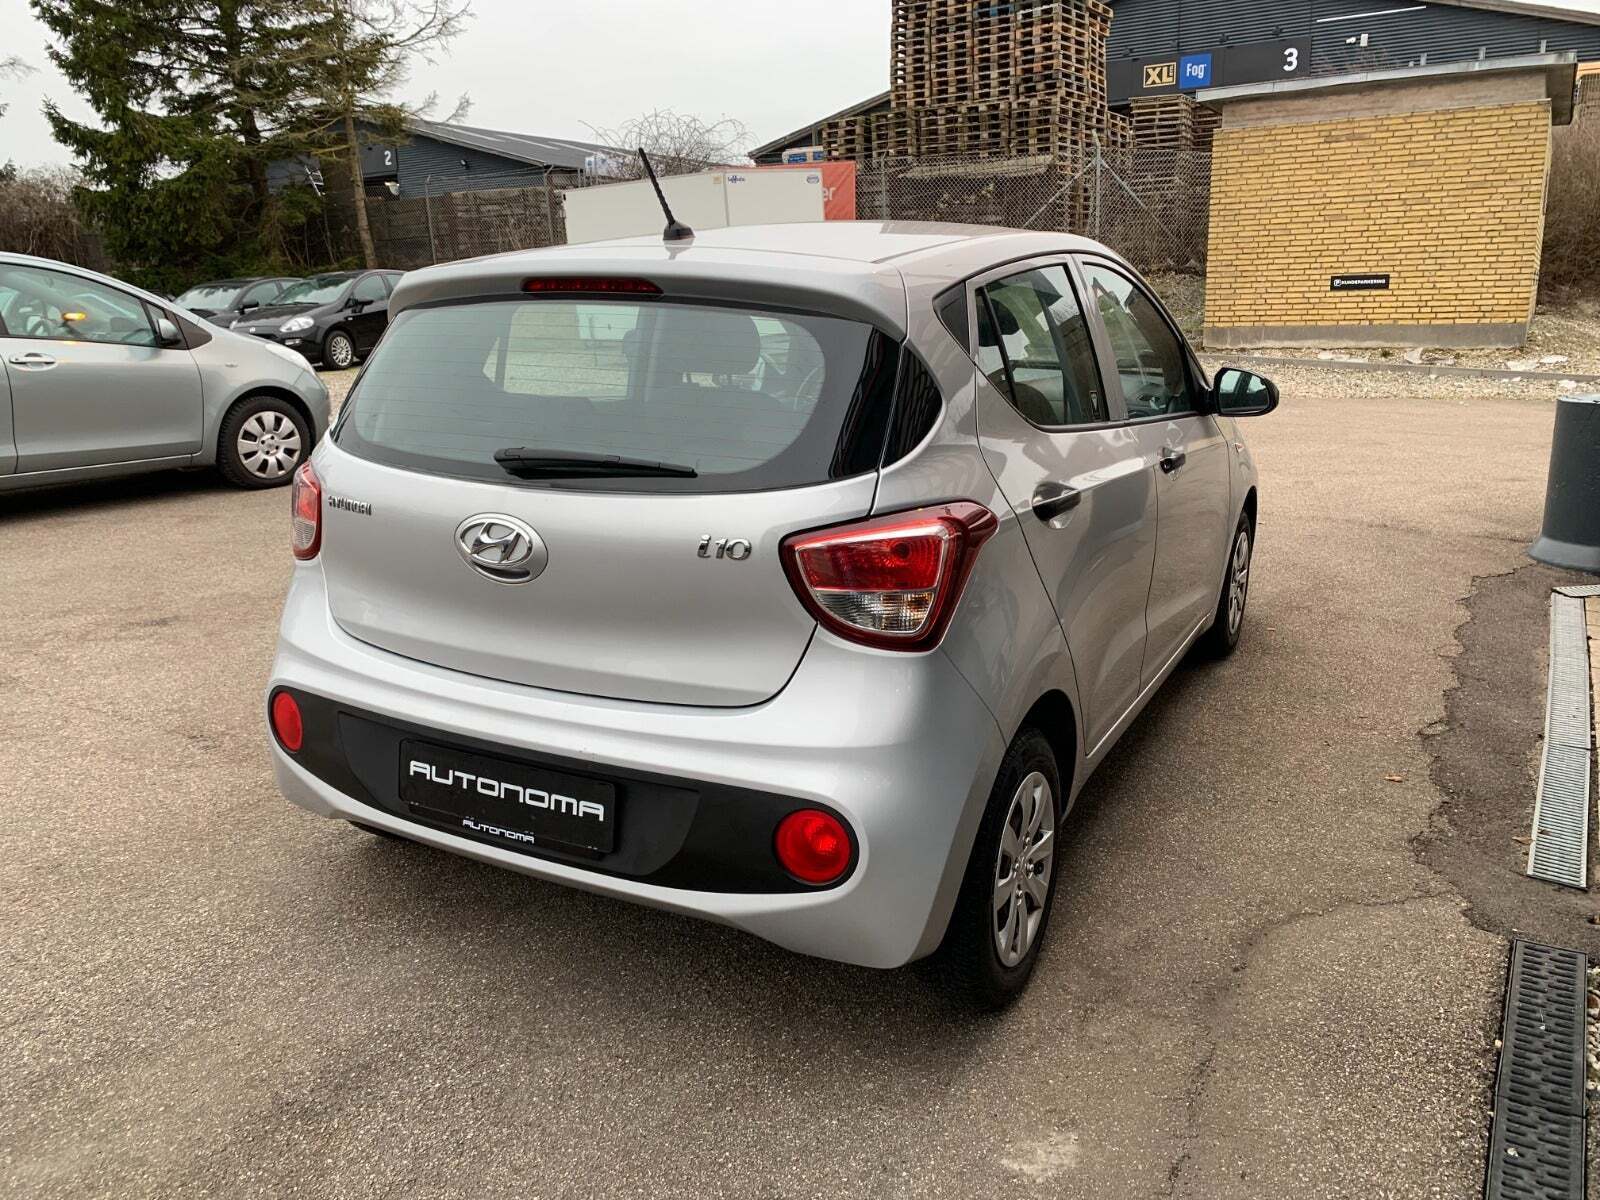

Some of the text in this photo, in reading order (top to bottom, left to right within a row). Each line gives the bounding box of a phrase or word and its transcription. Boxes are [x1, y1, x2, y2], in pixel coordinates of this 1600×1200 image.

[1186, 63, 1205, 79] Fog
[1283, 47, 1299, 72] 3
[384, 150, 392, 166] 2
[328, 495, 372, 516] HYUNDAI
[697, 534, 752, 560] i10
[409, 759, 605, 822] AUTONOMA
[462, 818, 535, 844] AUTONOMA
